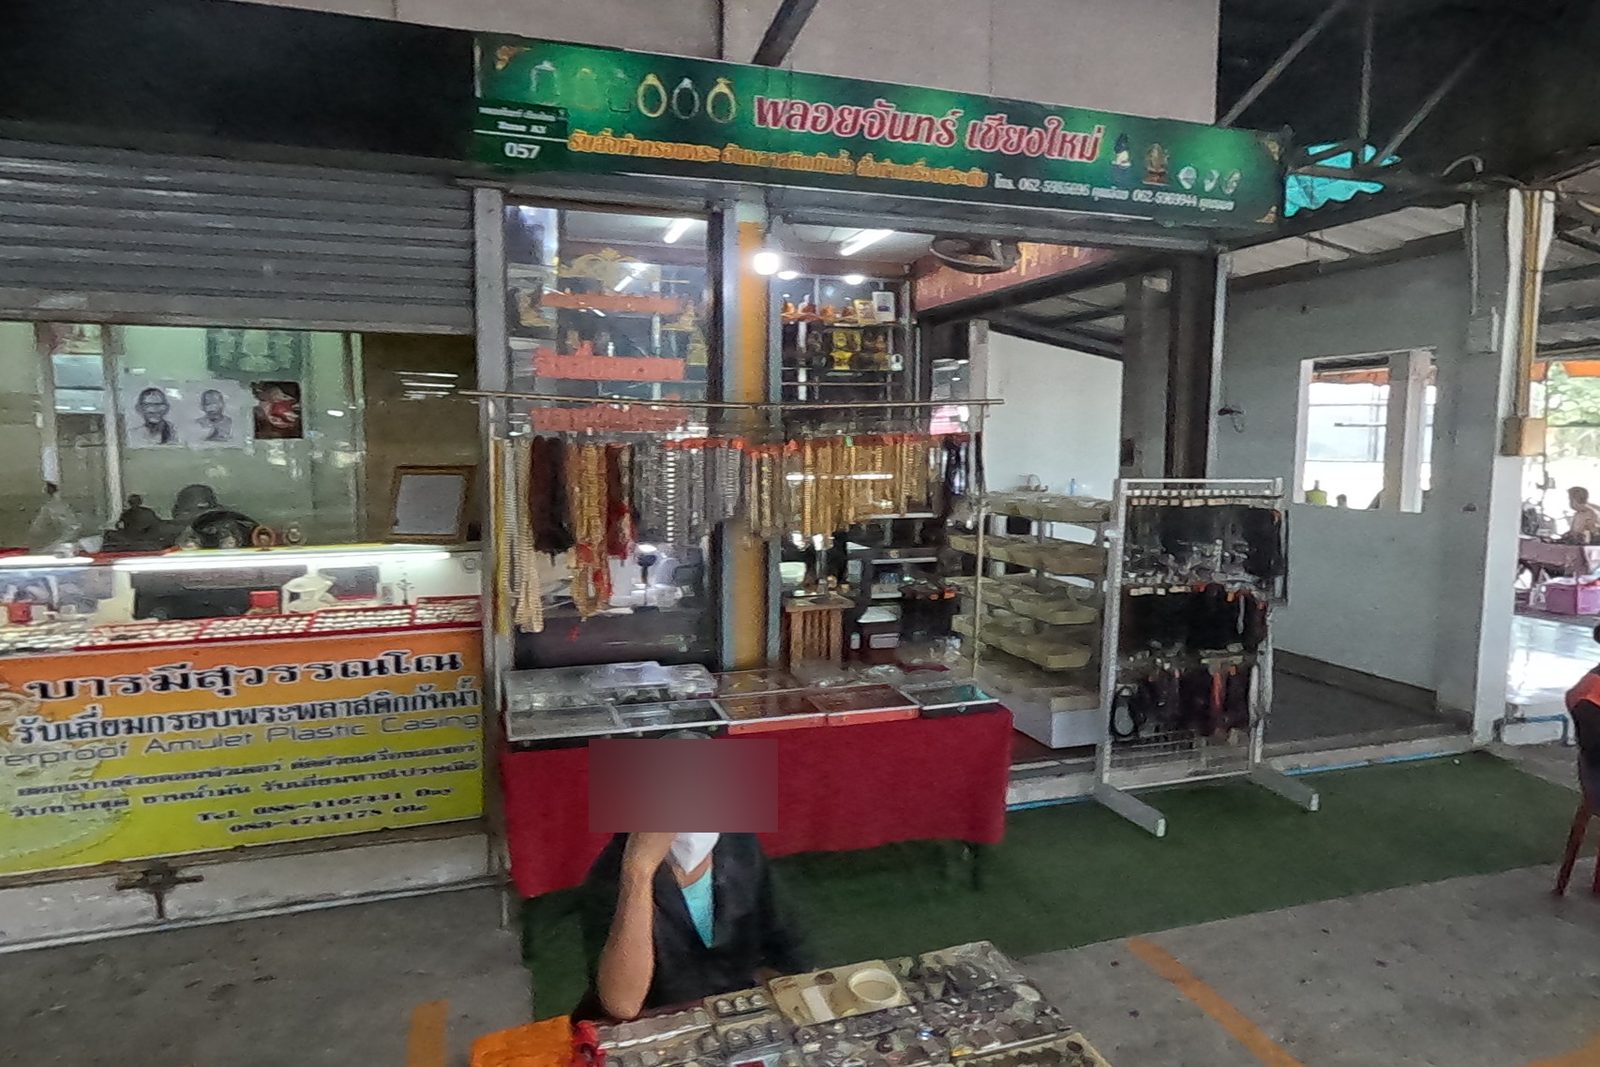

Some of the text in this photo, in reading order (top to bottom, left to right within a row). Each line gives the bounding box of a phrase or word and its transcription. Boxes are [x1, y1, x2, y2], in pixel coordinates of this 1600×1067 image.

[504, 142, 541, 159] 057
[754, 97, 1105, 163] พลอยจันทร์ เชียงใหม่
[27, 652, 462, 697] บารมีสุวรรณโณ
[0, 712, 479, 768] erproof Amulet Plastic Casing
